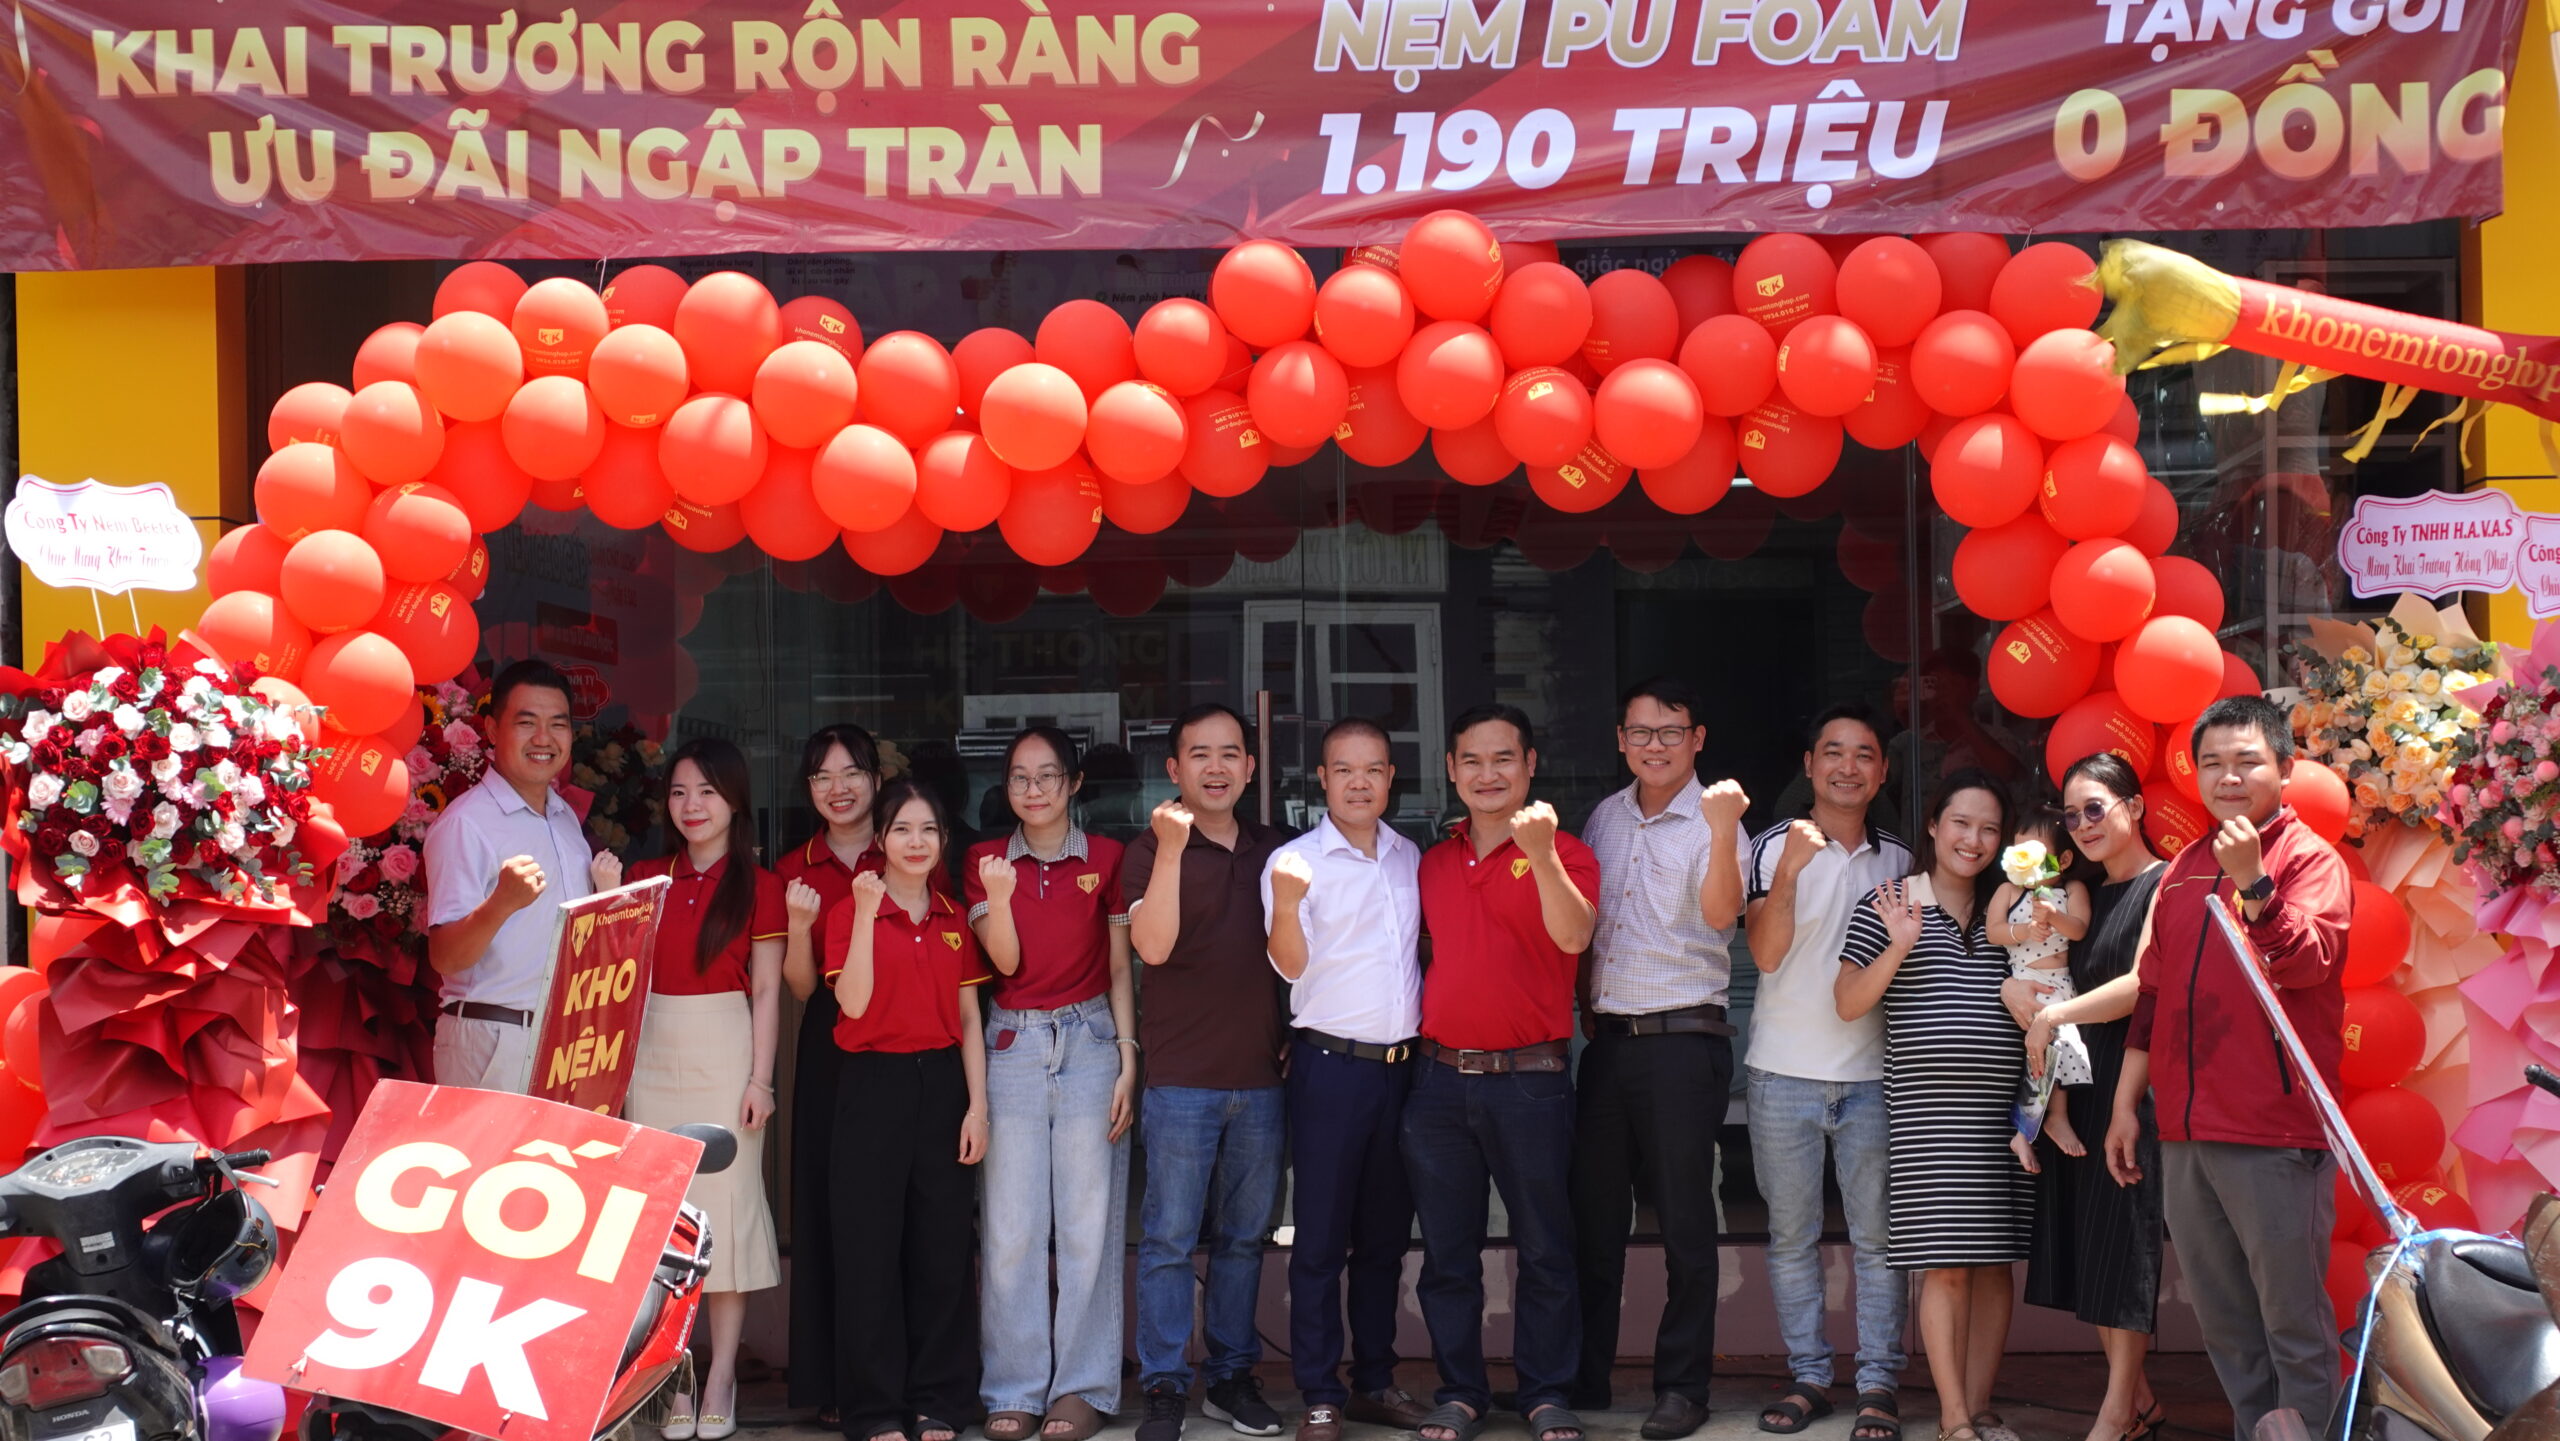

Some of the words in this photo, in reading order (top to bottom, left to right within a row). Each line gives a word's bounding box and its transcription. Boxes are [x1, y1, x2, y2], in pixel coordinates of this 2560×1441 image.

[92, 25, 308, 98] KHAI
[332, 8, 706, 97] TRƯƠNG
[732, 0, 923, 116] RỘN
[952, 0, 1200, 88] RÀNG
[1542, 0, 1675, 68] PU
[1692, 0, 1964, 66] FOAM
[208, 114, 335, 206] ƯU
[361, 108, 529, 201] ĐÃI
[559, 107, 824, 222] NGẬP
[847, 103, 1102, 200] TRÀN
[1319, 108, 1577, 195] 1.190
[1612, 79, 1951, 209] TRIỆU
[2053, 88, 2128, 184] 0
[2159, 49, 2505, 182] ĐỒNG
[2357, 526, 2388, 547] Công
[2393, 525, 2407, 546] Ty
[2411, 522, 2449, 542] TNHH
[2453, 519, 2513, 539] H.A.V.A.S
[563, 959, 637, 1016] KHO
[546, 1026, 625, 1091] NỆM
[355, 1138, 648, 1284] GỐI
[304, 1257, 588, 1421] 9K
[52, 1409, 90, 1423] HONDA
